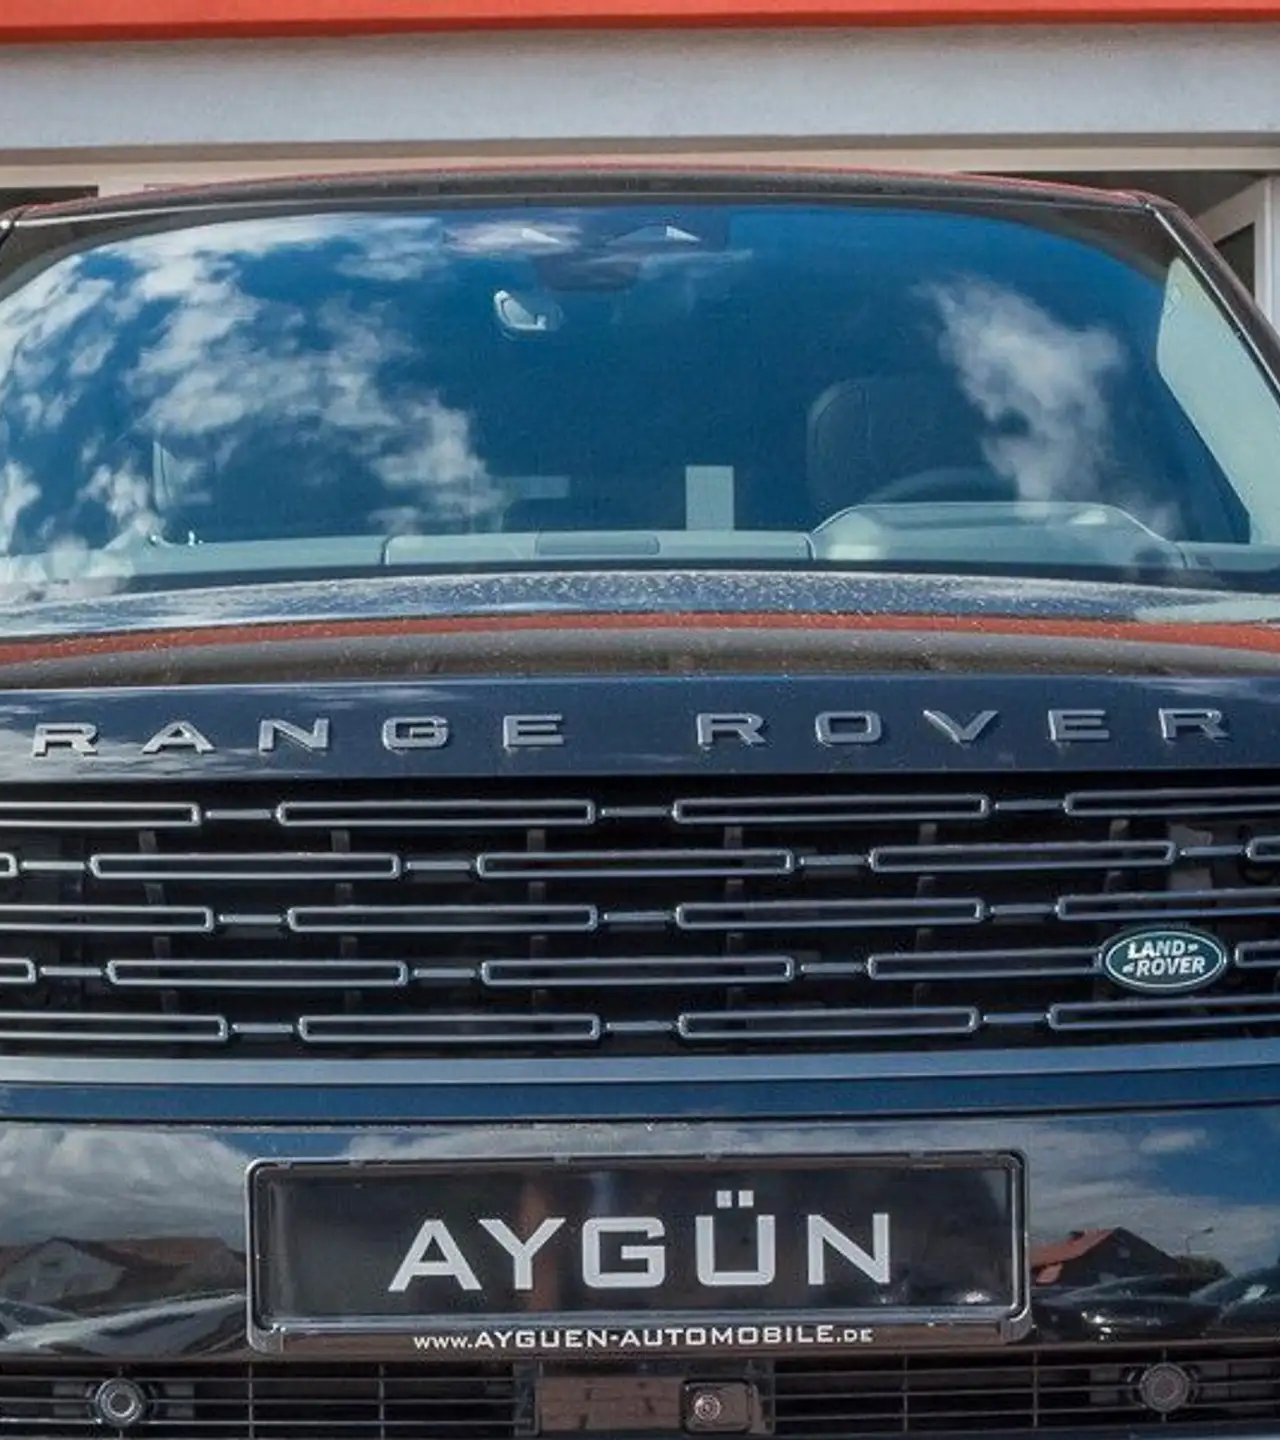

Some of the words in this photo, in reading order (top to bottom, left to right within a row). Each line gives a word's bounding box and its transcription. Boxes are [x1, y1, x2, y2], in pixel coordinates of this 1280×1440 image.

[32, 714, 565, 757] RANGE
[695, 707, 1230, 747] ROVER
[1127, 940, 1185, 959] LAND
[1136, 956, 1206, 977] ROVER
[388, 1190, 891, 1292] AYGÜN
